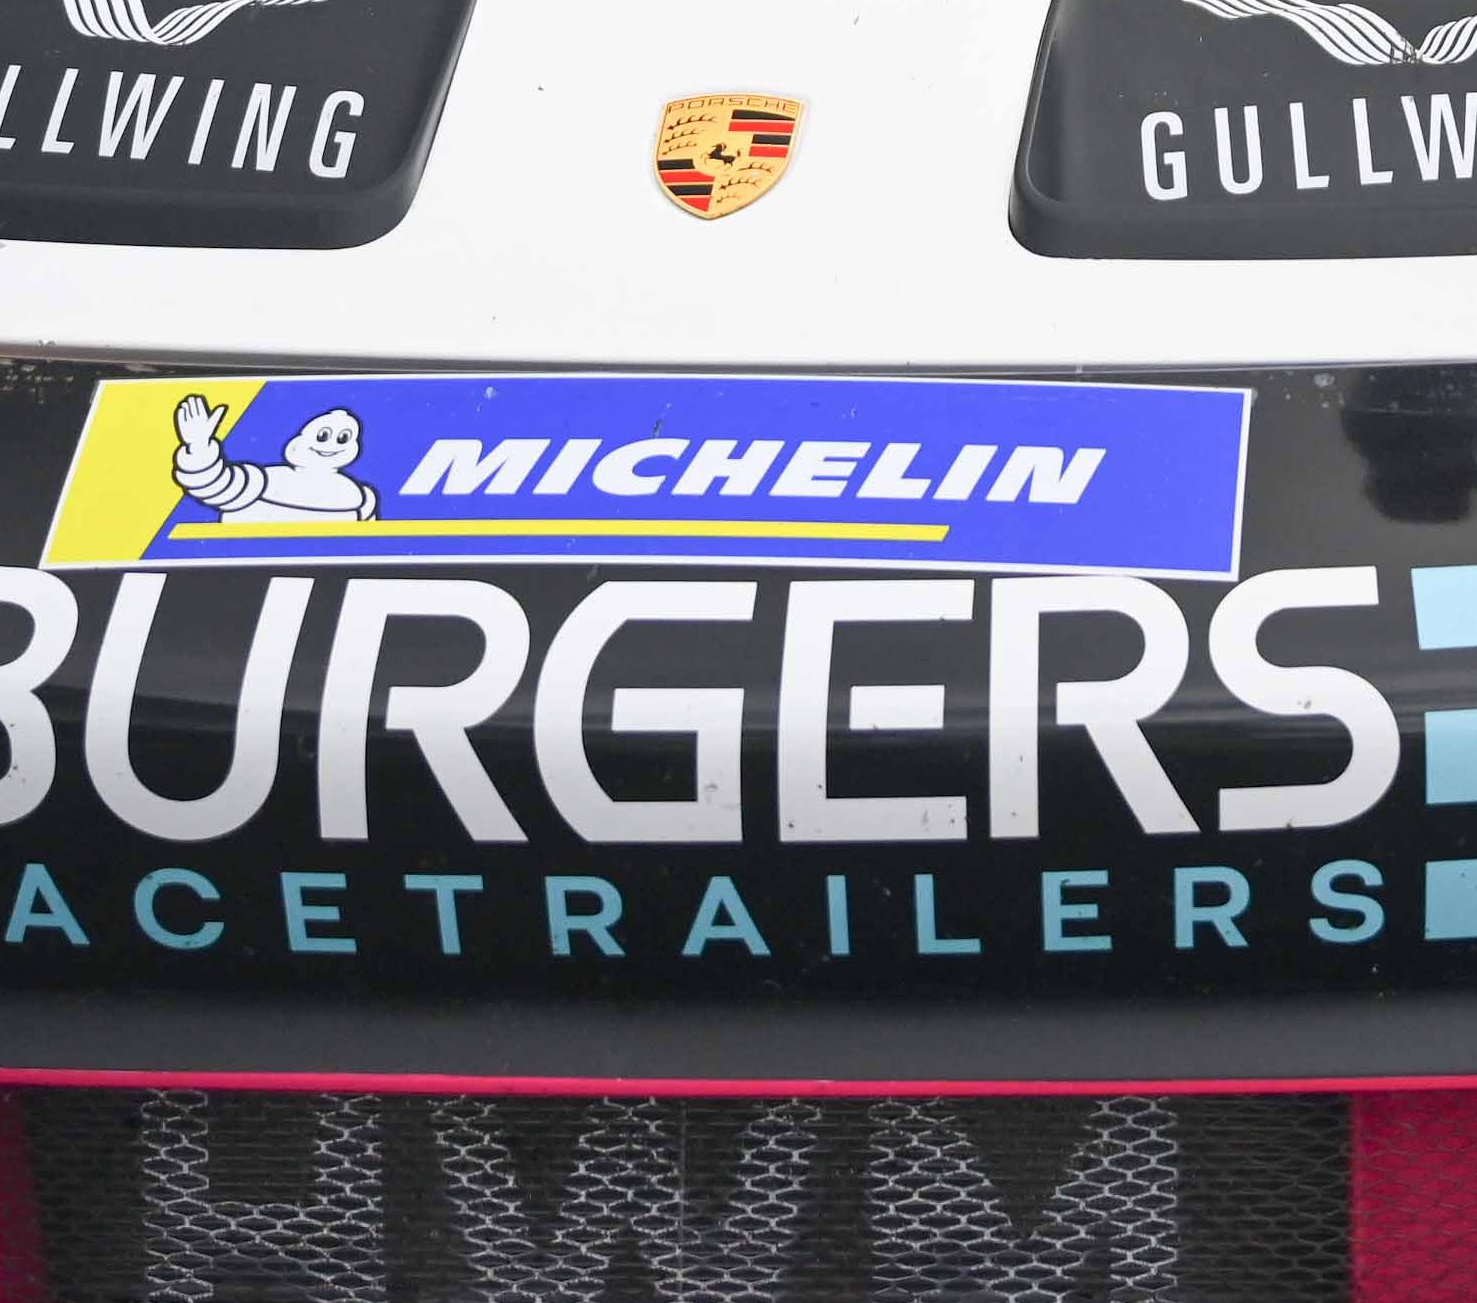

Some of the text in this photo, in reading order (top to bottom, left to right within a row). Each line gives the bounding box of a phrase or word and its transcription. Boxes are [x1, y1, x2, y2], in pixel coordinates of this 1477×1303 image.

[667, 96, 797, 115] PORSCHE
[398, 437, 1108, 506] MICHELIN
[143, 1088, 1180, 1303] HWM
